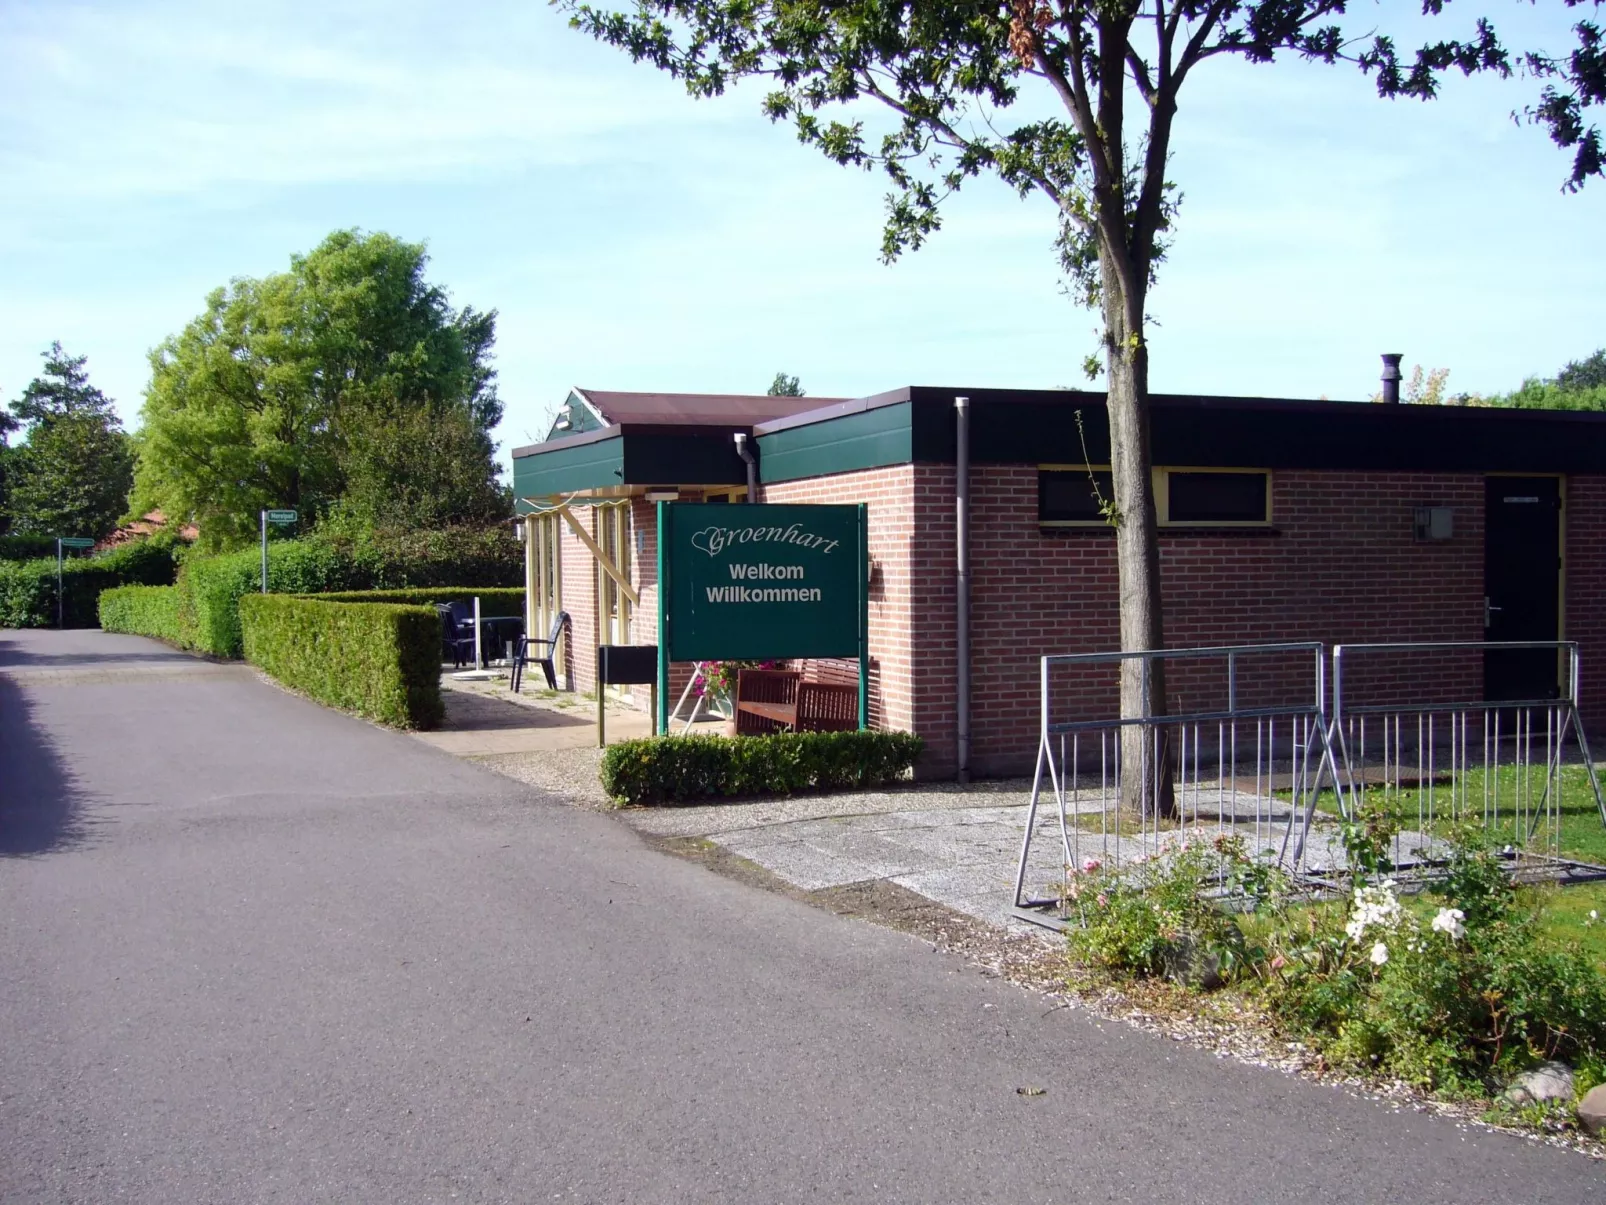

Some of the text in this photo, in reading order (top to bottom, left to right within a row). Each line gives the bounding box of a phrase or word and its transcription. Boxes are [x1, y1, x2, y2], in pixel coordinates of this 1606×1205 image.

[708, 523, 840, 556] Groenhart
[729, 563, 804, 580] Welkom
[706, 586, 822, 603] Willkommen
